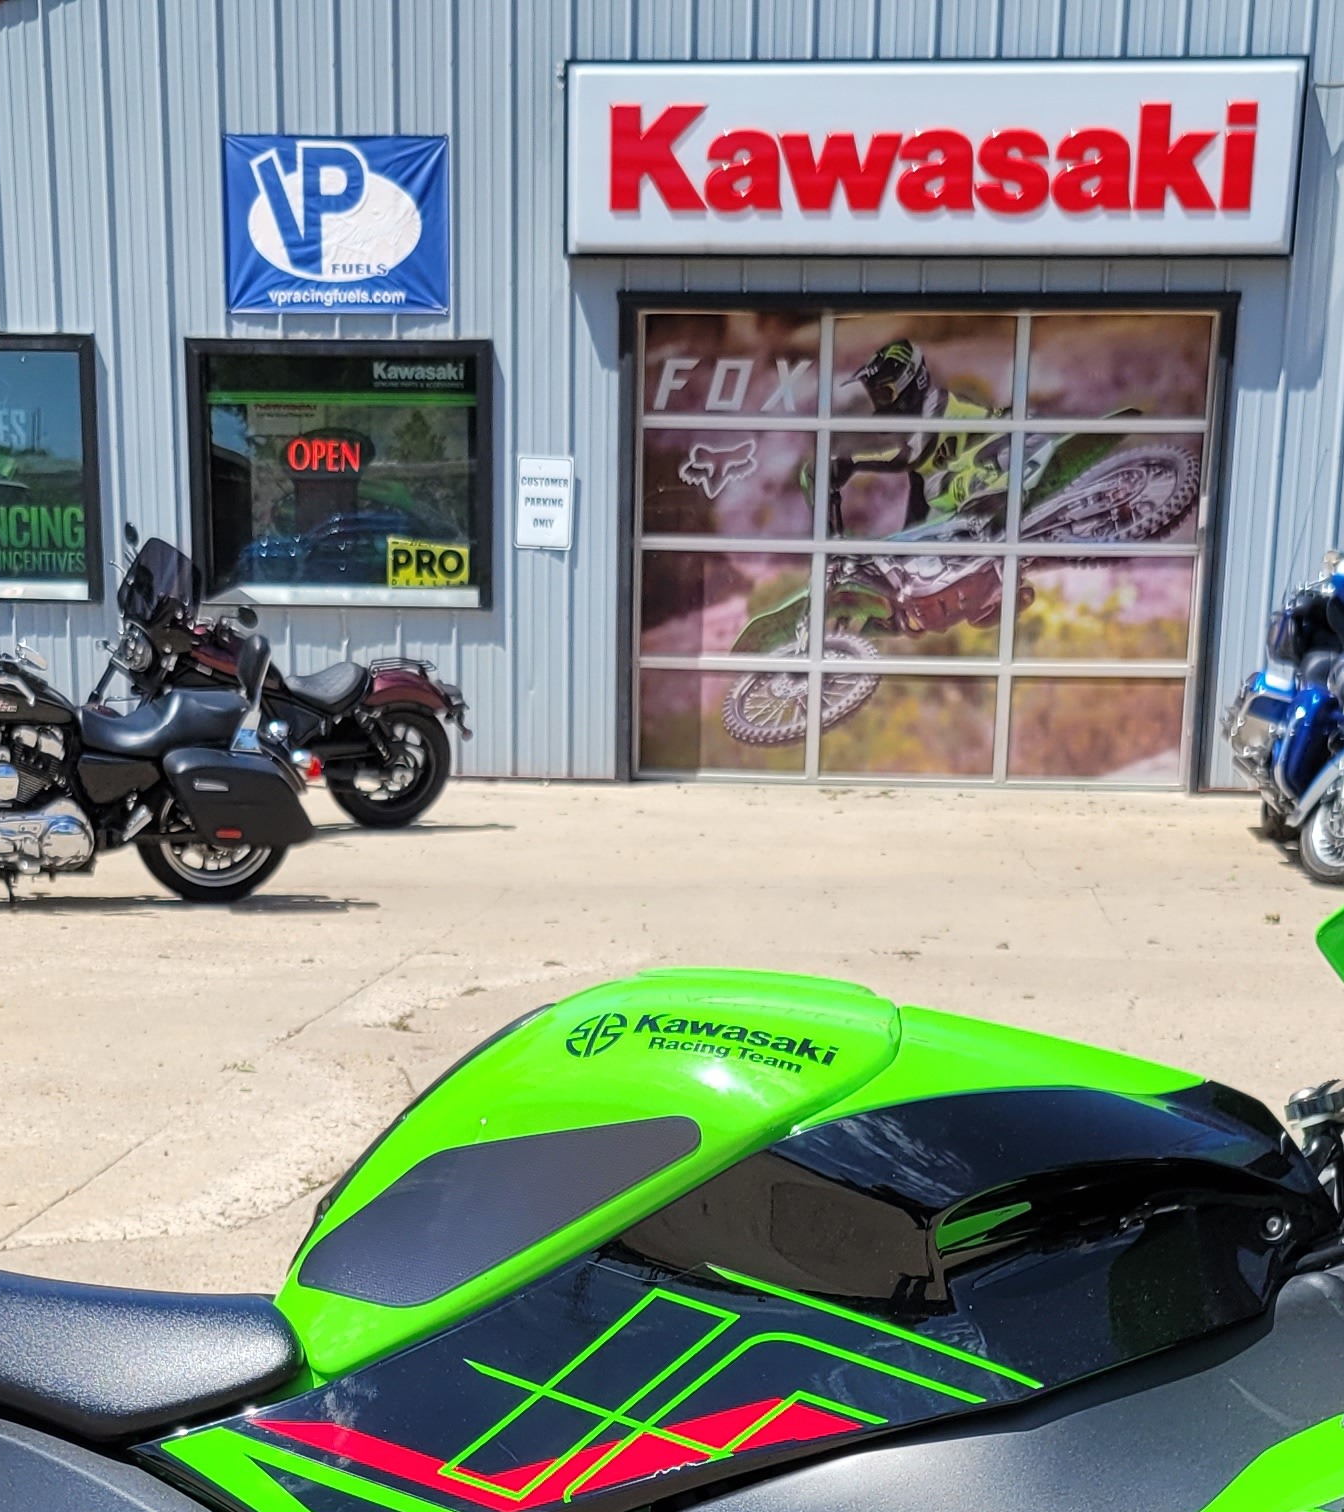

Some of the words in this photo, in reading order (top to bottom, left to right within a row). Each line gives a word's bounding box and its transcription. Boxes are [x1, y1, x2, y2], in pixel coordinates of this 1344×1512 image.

[610, 100, 1257, 212] Kawasaki
[250, 141, 367, 277] VP
[331, 264, 387, 275] FUELS
[268, 288, 405, 306] vpracingfuels.com
[373, 362, 464, 380] Kawasaki
[653, 358, 815, 412] FOX
[287, 438, 361, 472] OPEN
[521, 477, 568, 488] CUSTOMER
[524, 497, 563, 508] PARKING
[532, 518, 554, 528] ONLY
[392, 549, 465, 579] PRO
[633, 1013, 839, 1066] Kawasaki
[648, 1037, 732, 1060] Racing
[737, 1046, 803, 1073] Team
